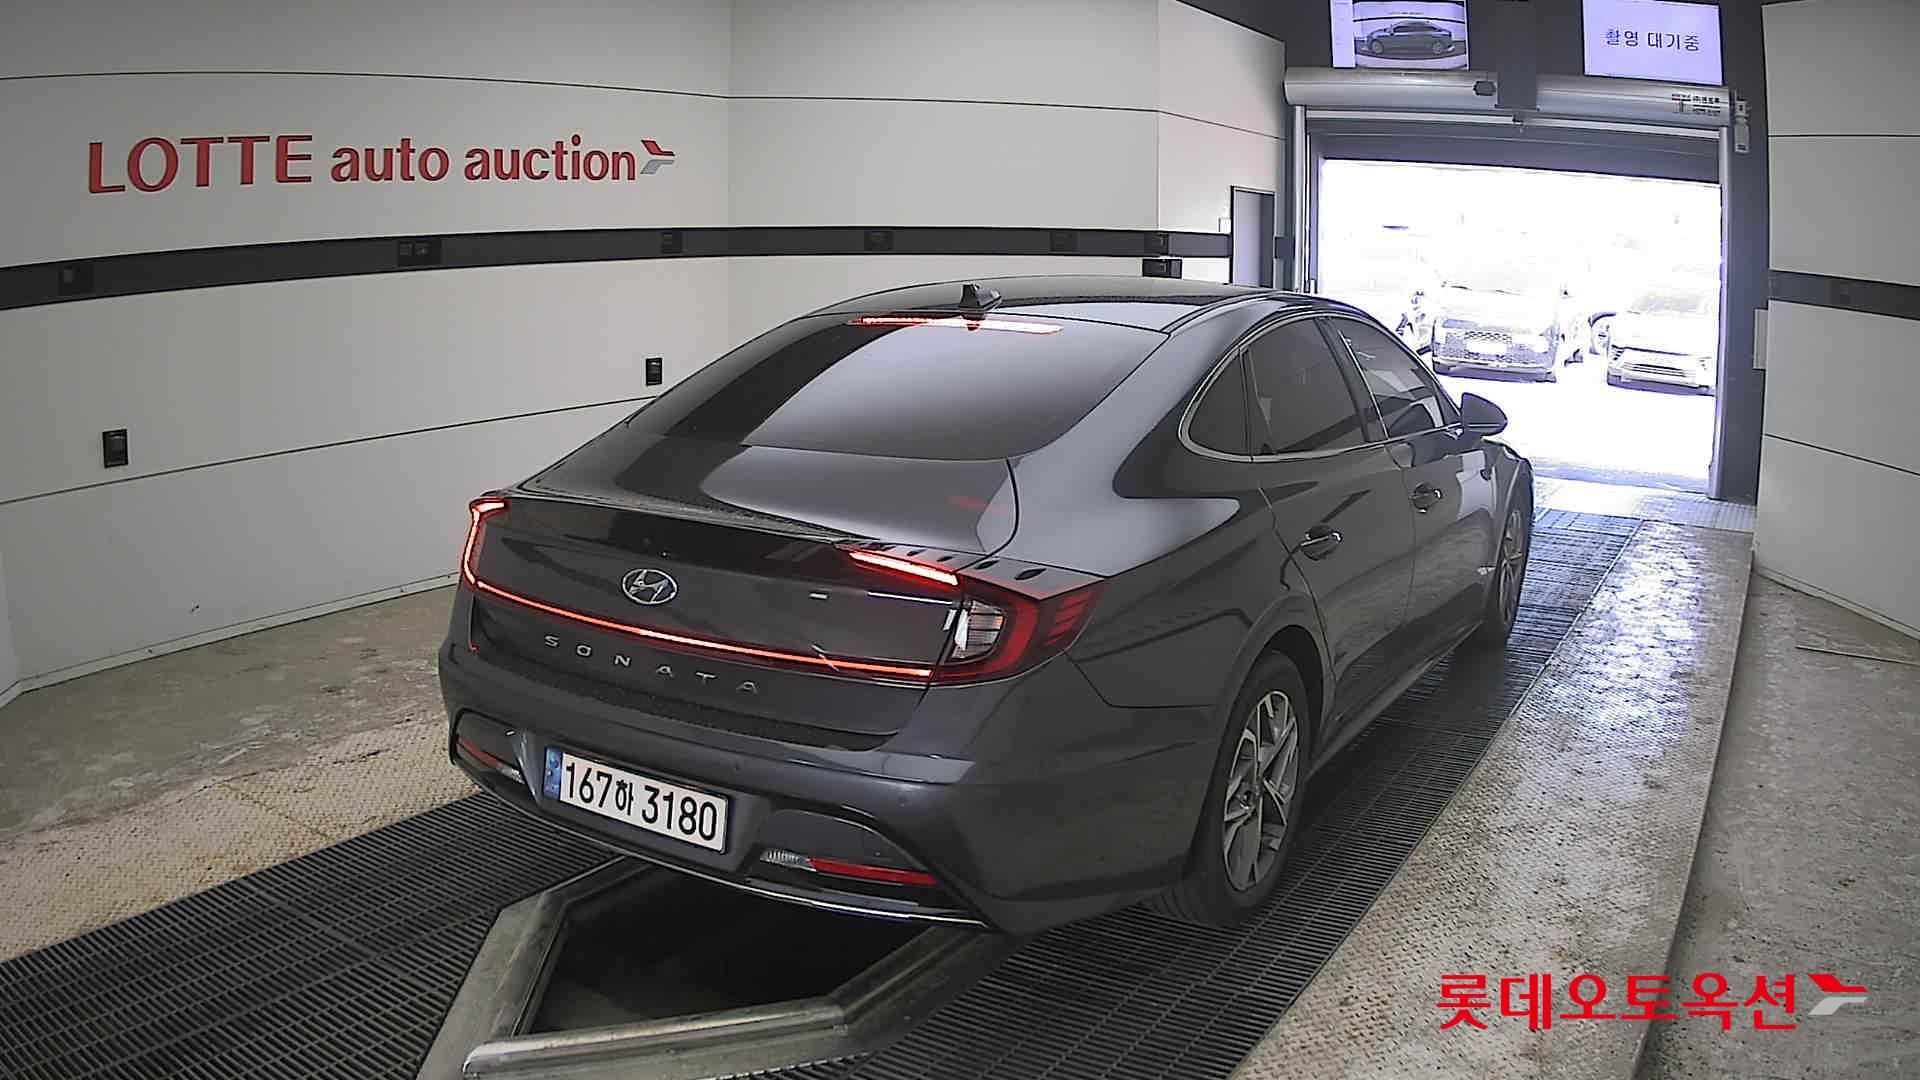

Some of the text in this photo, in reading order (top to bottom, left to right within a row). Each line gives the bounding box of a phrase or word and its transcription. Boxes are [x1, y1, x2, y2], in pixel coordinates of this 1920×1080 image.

[1647, 32, 1699, 51] 대기중
[88, 134, 637, 193] LOTTE auto auction
[543, 634, 759, 693] SONATA
[566, 762, 718, 841] 167하 3180
